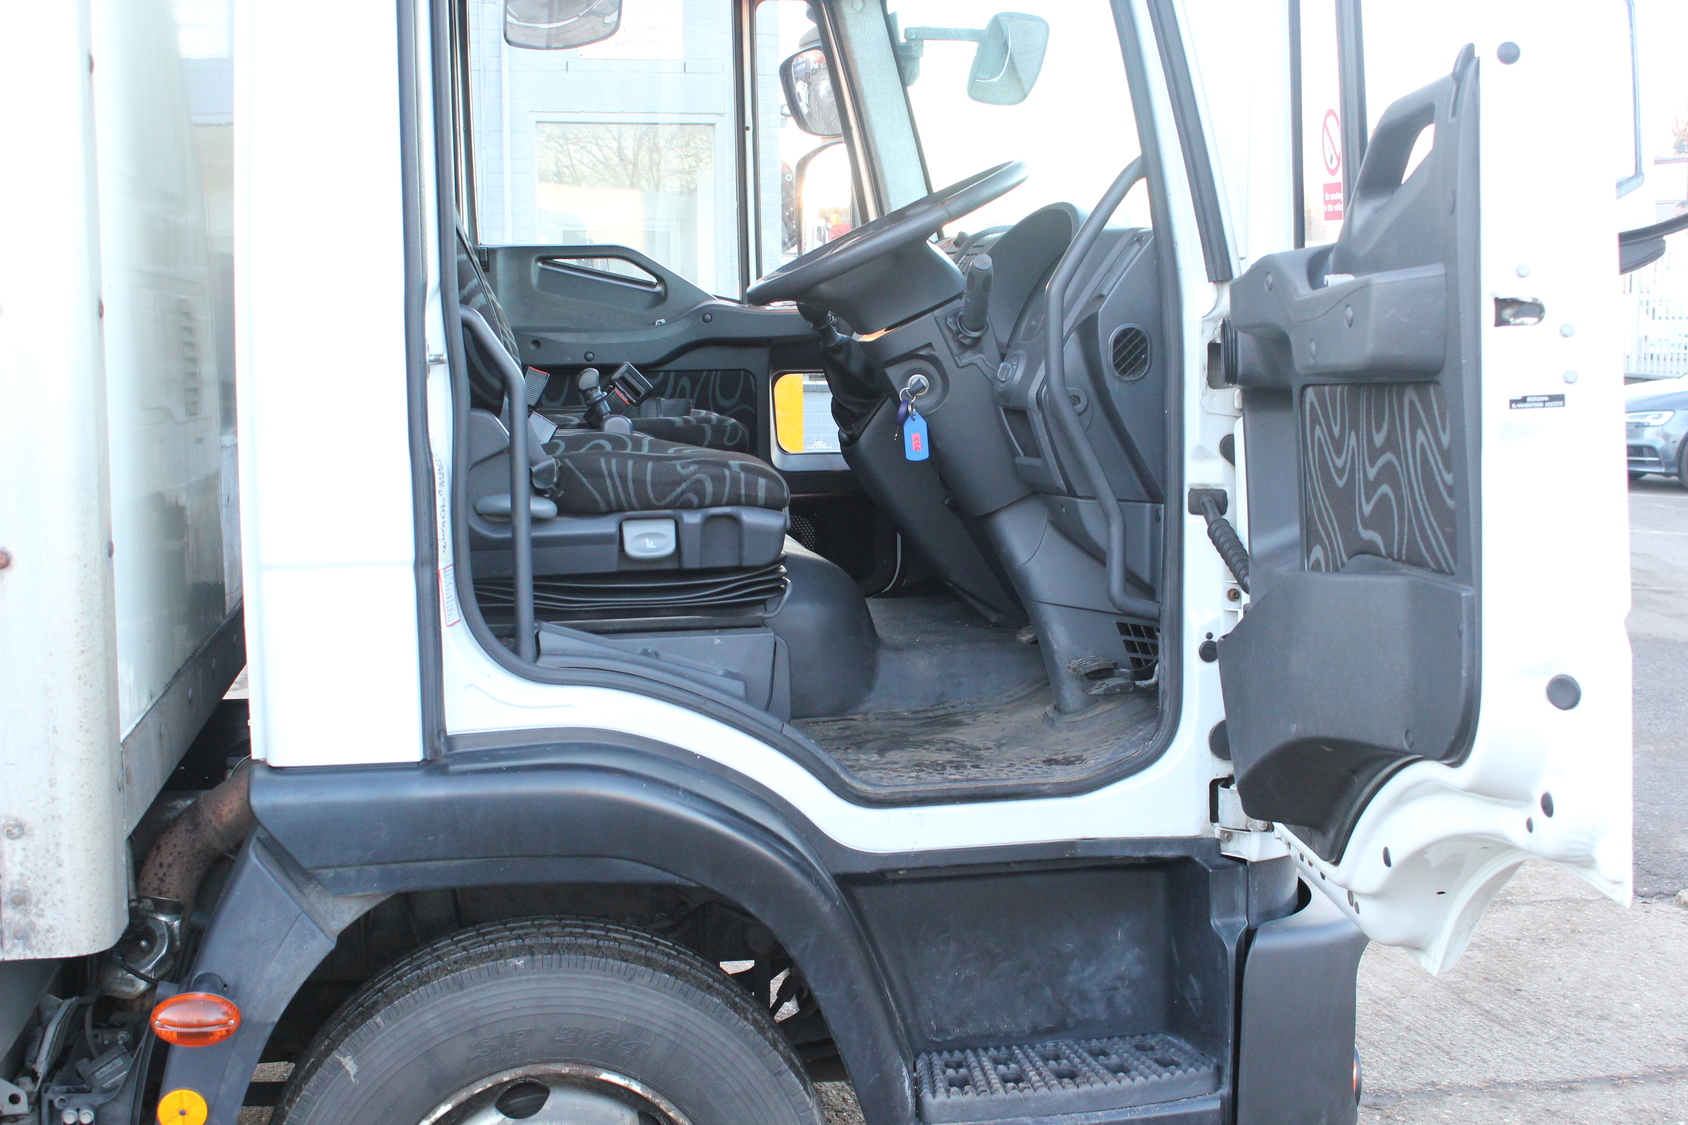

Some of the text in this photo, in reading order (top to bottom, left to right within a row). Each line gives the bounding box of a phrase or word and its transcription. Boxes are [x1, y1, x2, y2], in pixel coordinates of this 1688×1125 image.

[632, 23, 672, 32] Cameras
[615, 36, 660, 47] Operation
[468, 1025, 651, 1062] SP 344
